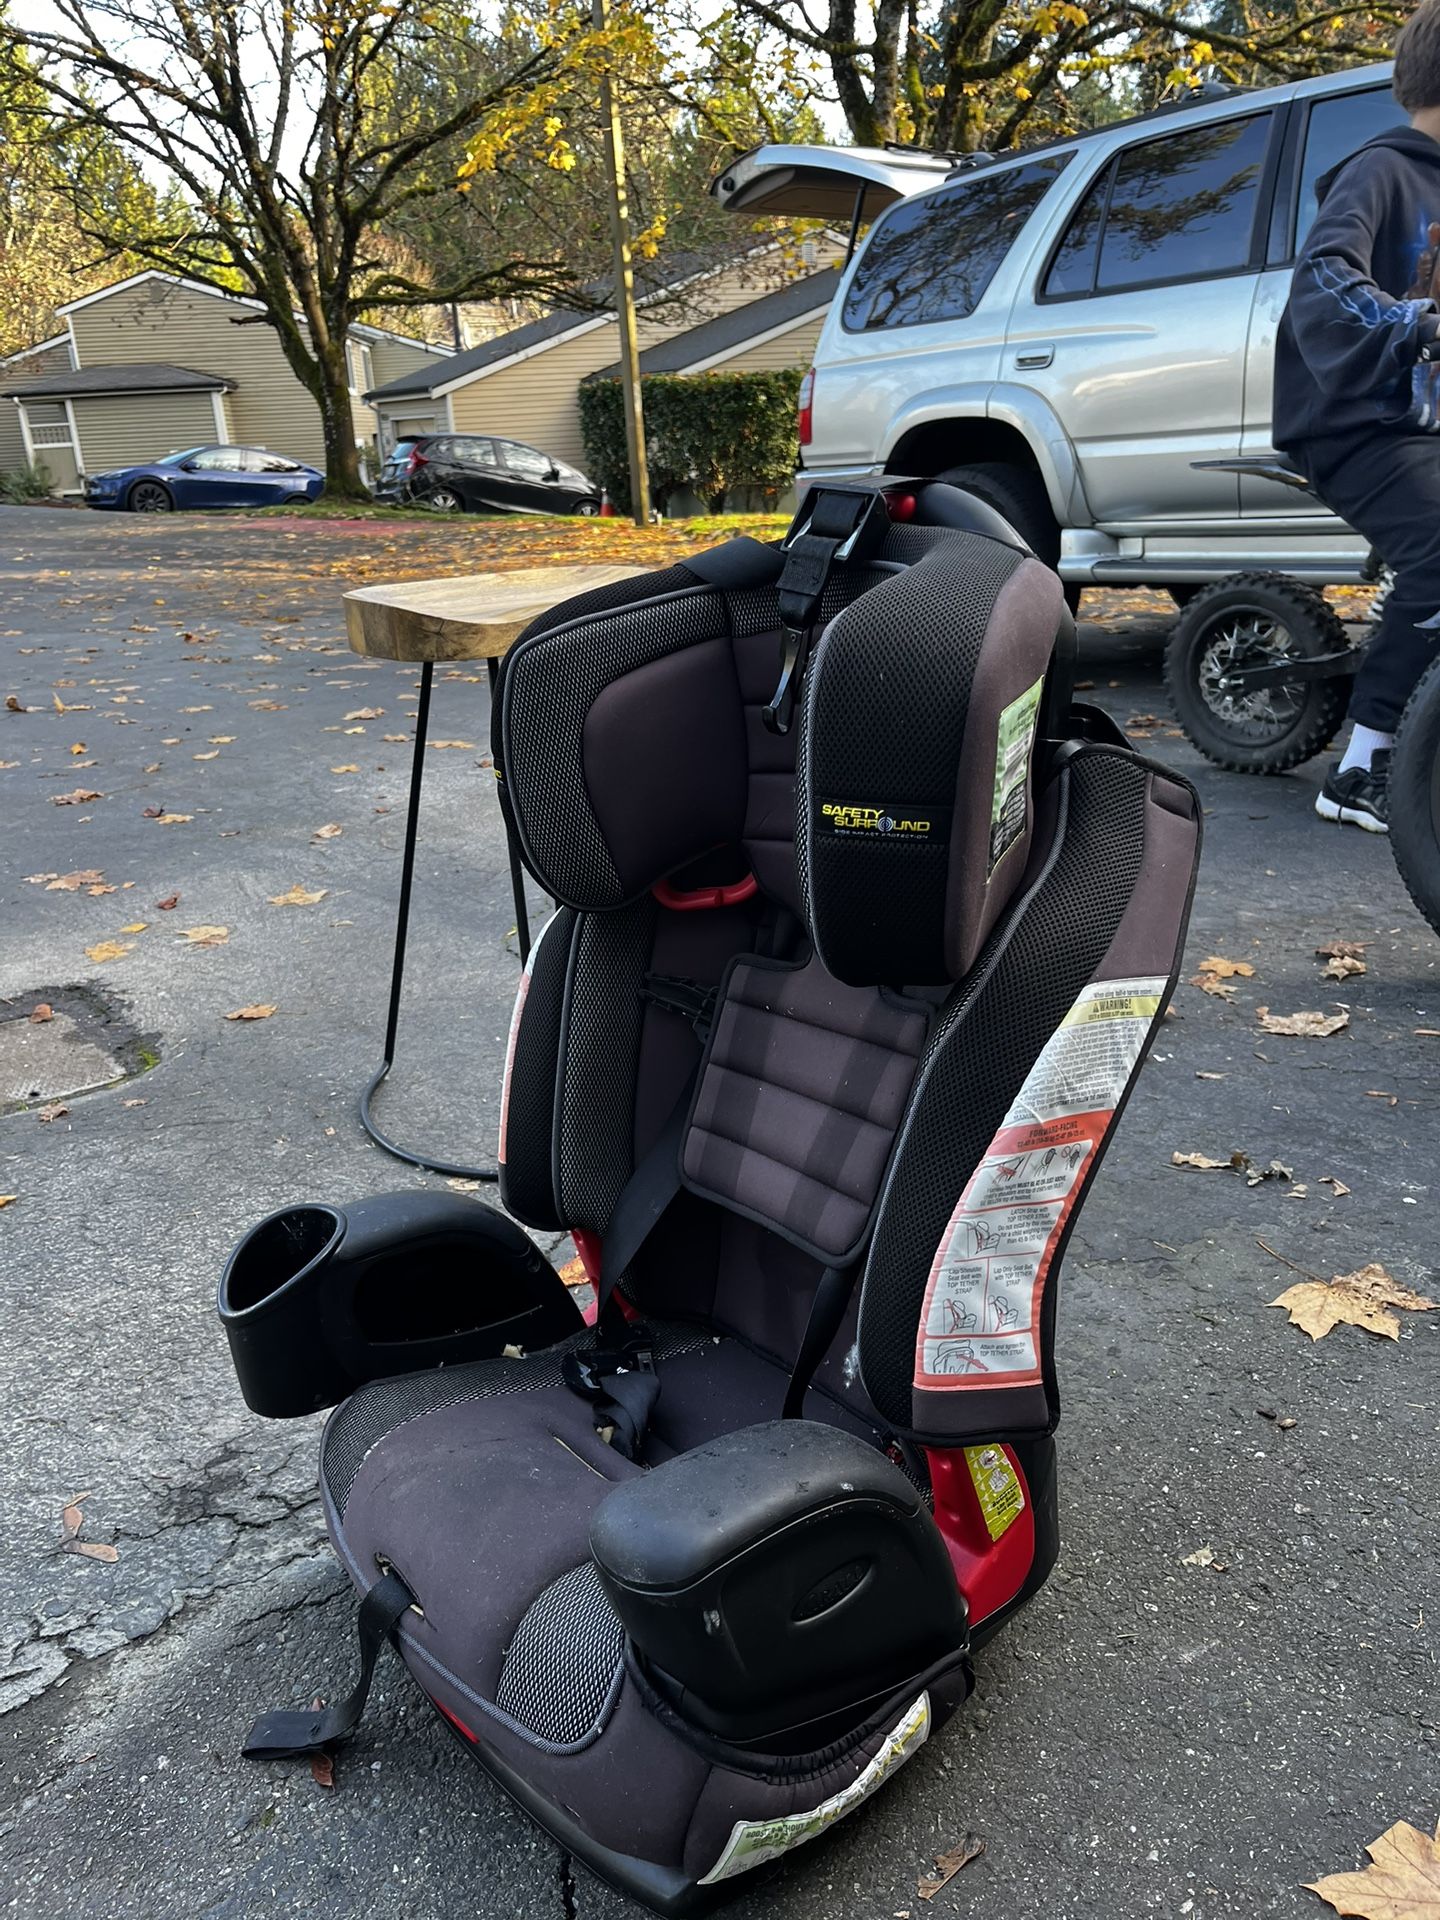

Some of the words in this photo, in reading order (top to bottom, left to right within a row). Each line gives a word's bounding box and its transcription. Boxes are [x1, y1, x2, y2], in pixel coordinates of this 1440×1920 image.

[822, 804, 884, 819] SAFETY
[834, 816, 930, 832] SURROUND
[1100, 999, 1132, 1012] WARNING!
[1006, 1279, 1021, 1287] STRAP
